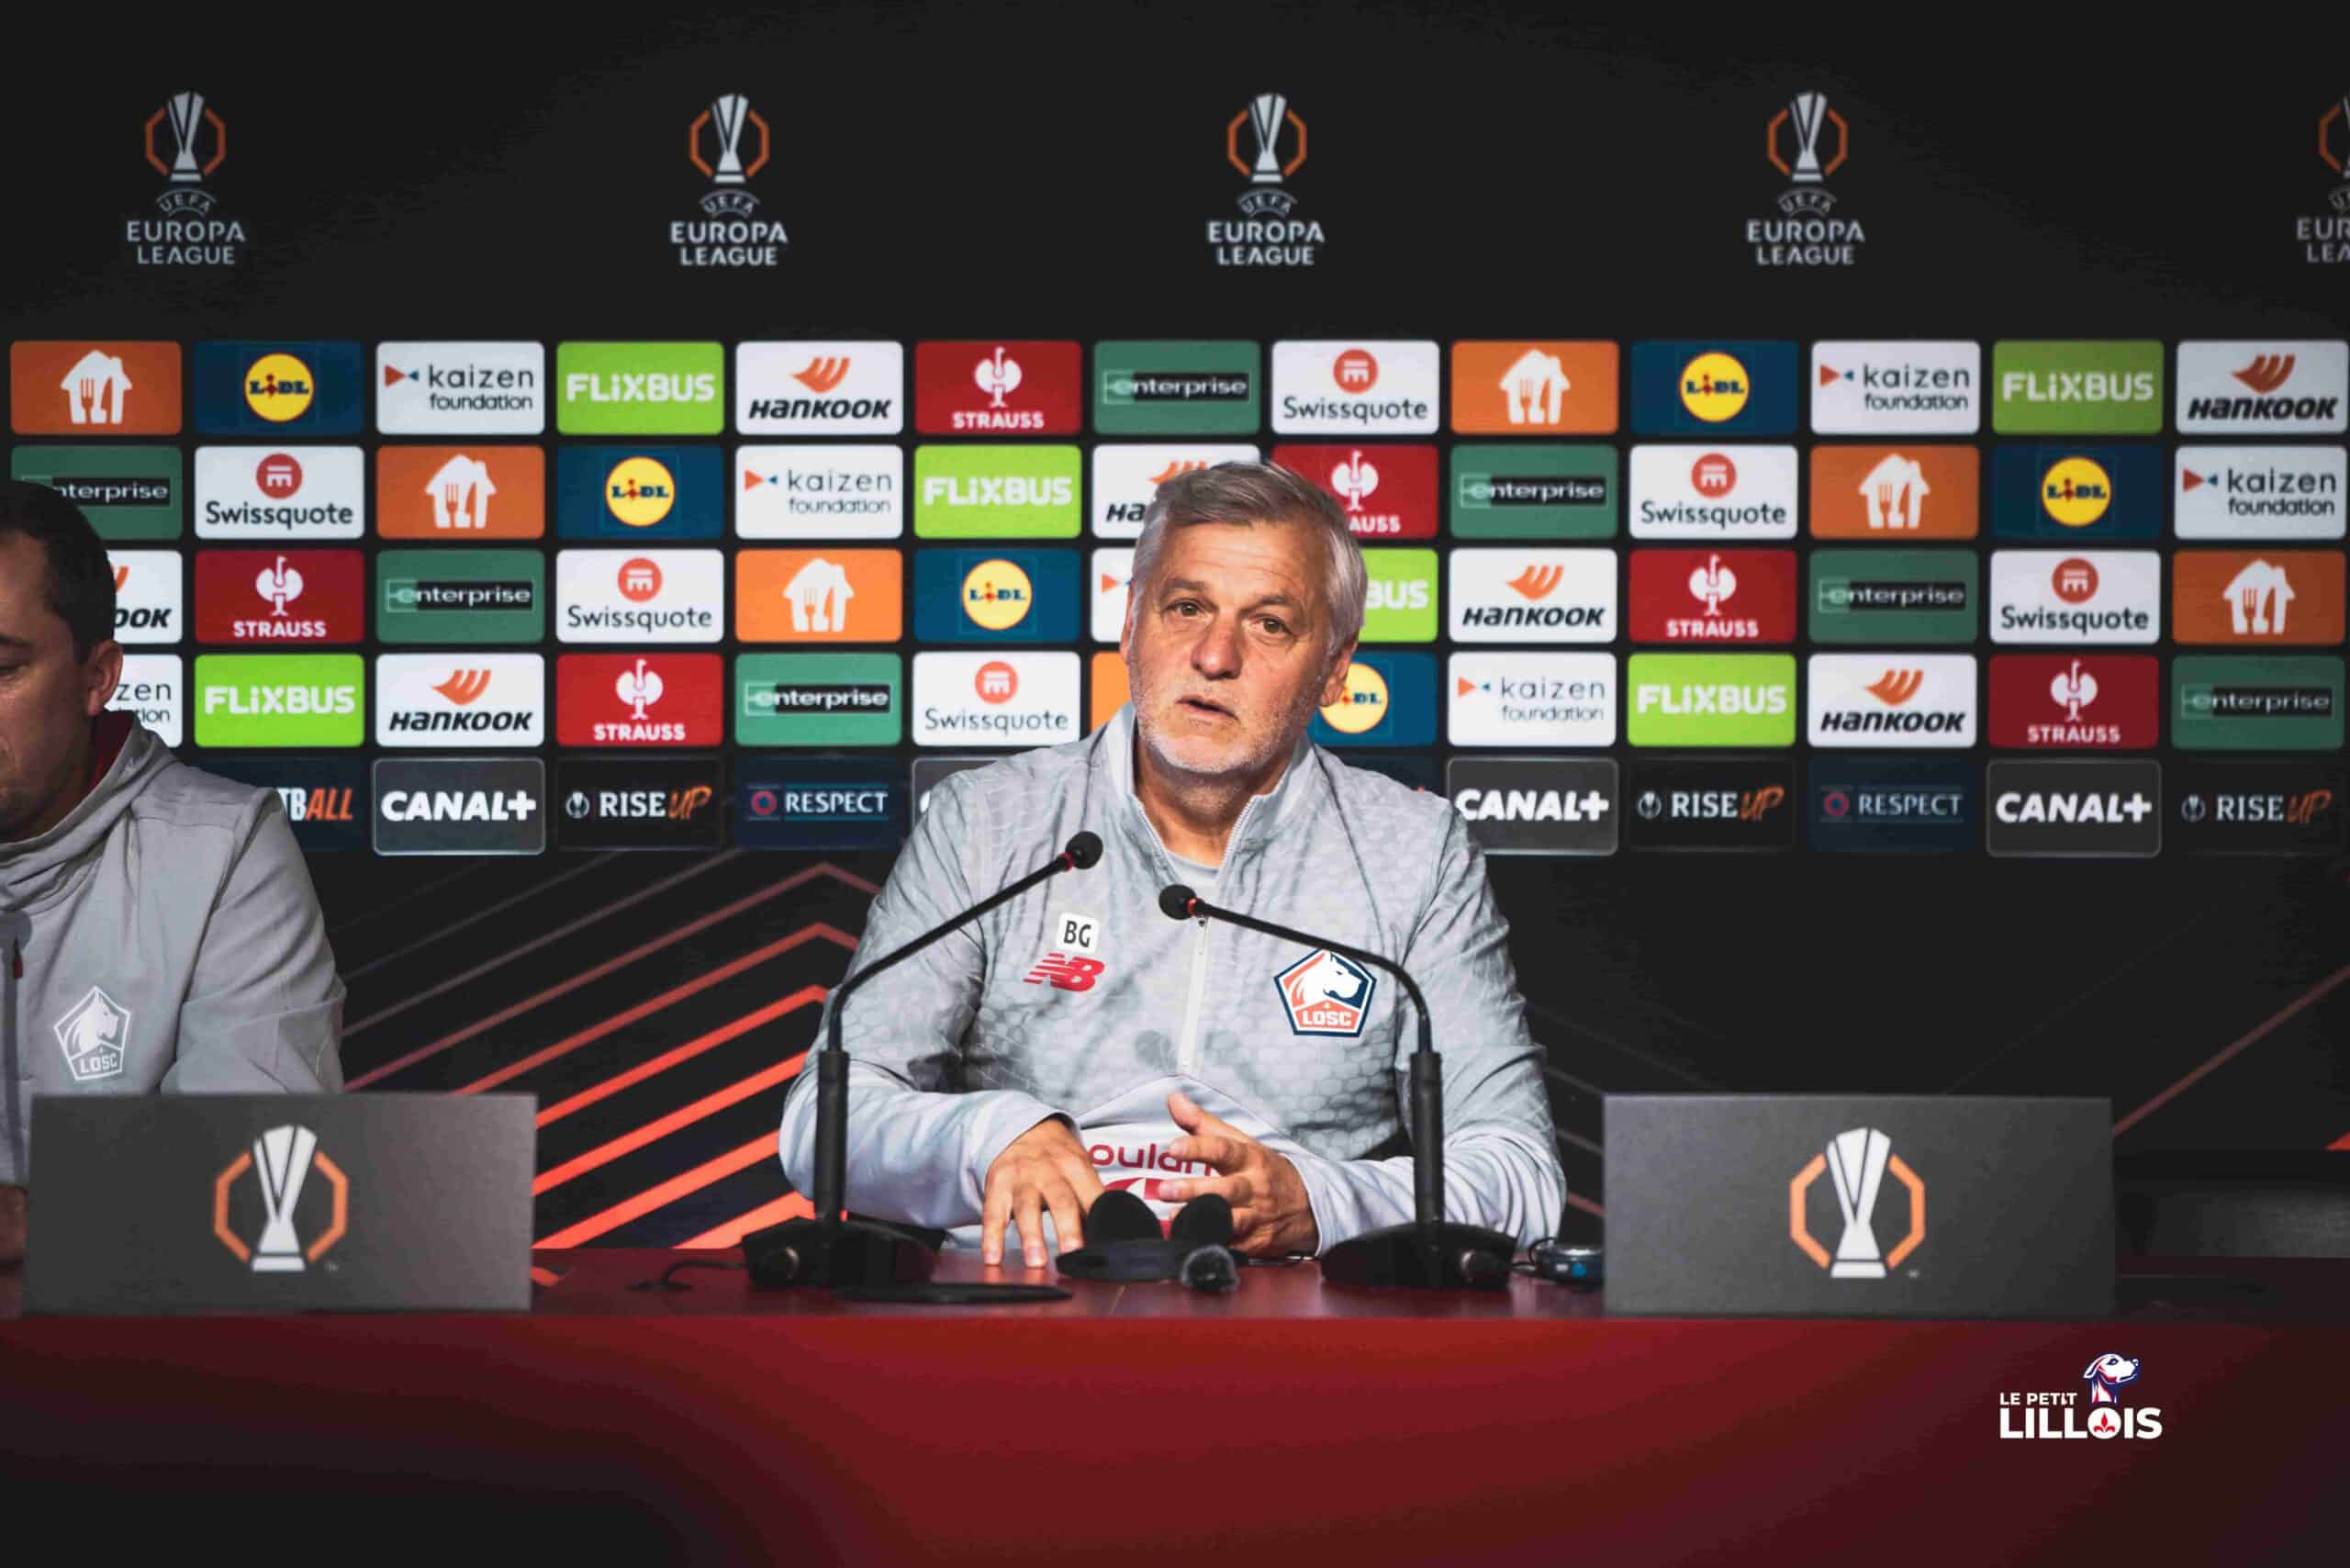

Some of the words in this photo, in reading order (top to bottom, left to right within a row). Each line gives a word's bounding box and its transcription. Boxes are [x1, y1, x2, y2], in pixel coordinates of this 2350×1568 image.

[159, 193, 210, 212] UEFA
[127, 219, 246, 242] EUROPA
[670, 220, 788, 243] EUROPA
[1208, 220, 1325, 243] EUROPA
[1747, 219, 1865, 243] EUROPA
[2297, 217, 2350, 241] EUR
[138, 245, 235, 265] LEAGUE
[680, 246, 778, 266] LEAGUE
[1218, 246, 1315, 265] LEAGUE
[1757, 245, 1854, 265] LEAGUE
[428, 364, 534, 389] kaizen
[1113, 376, 1248, 398] enterprise
[1863, 364, 1970, 388] kaizen
[429, 393, 533, 410] foundation
[1283, 397, 1428, 423] Swissquote
[1864, 393, 1968, 410] foundation
[952, 410, 1045, 429] STRAUSS
[58, 480, 168, 503] nterprise
[787, 468, 892, 493] kaizen
[1470, 479, 1605, 502] enterprise
[2227, 467, 2336, 494] kaizen
[205, 500, 353, 529] Swissquote
[788, 496, 890, 514] foundation
[1640, 500, 1786, 528] Swissquote
[2228, 498, 2334, 516] foundation
[1348, 515, 1401, 532] AUSS
[396, 584, 532, 605] enterprise
[1827, 588, 1964, 608] enterprise
[567, 604, 712, 632] Swissquote
[1666, 620, 1759, 638] STRAUSS
[2000, 606, 2149, 634] Swissquote
[233, 621, 326, 638] STRAUSS
[117, 683, 172, 700] zen
[753, 688, 890, 708] enterprise
[1500, 675, 1606, 700] kaizen
[1501, 702, 1604, 721] foundation
[2192, 693, 2330, 712] enterprise
[593, 723, 686, 741] STRAUSS
[924, 709, 1069, 735] Swissquote
[2028, 726, 2120, 743] STRAUSS
[380, 791, 537, 821] CANAL+
[785, 791, 889, 814] RESPECT
[1454, 788, 1609, 822] CANAL+
[1859, 792, 1964, 814] RESPECT
[1996, 792, 2152, 823] CANAL+
[1064, 920, 1091, 947] BG
[1302, 1011, 1352, 1026] LOSC
[80, 1053, 118, 1072] LOSC
